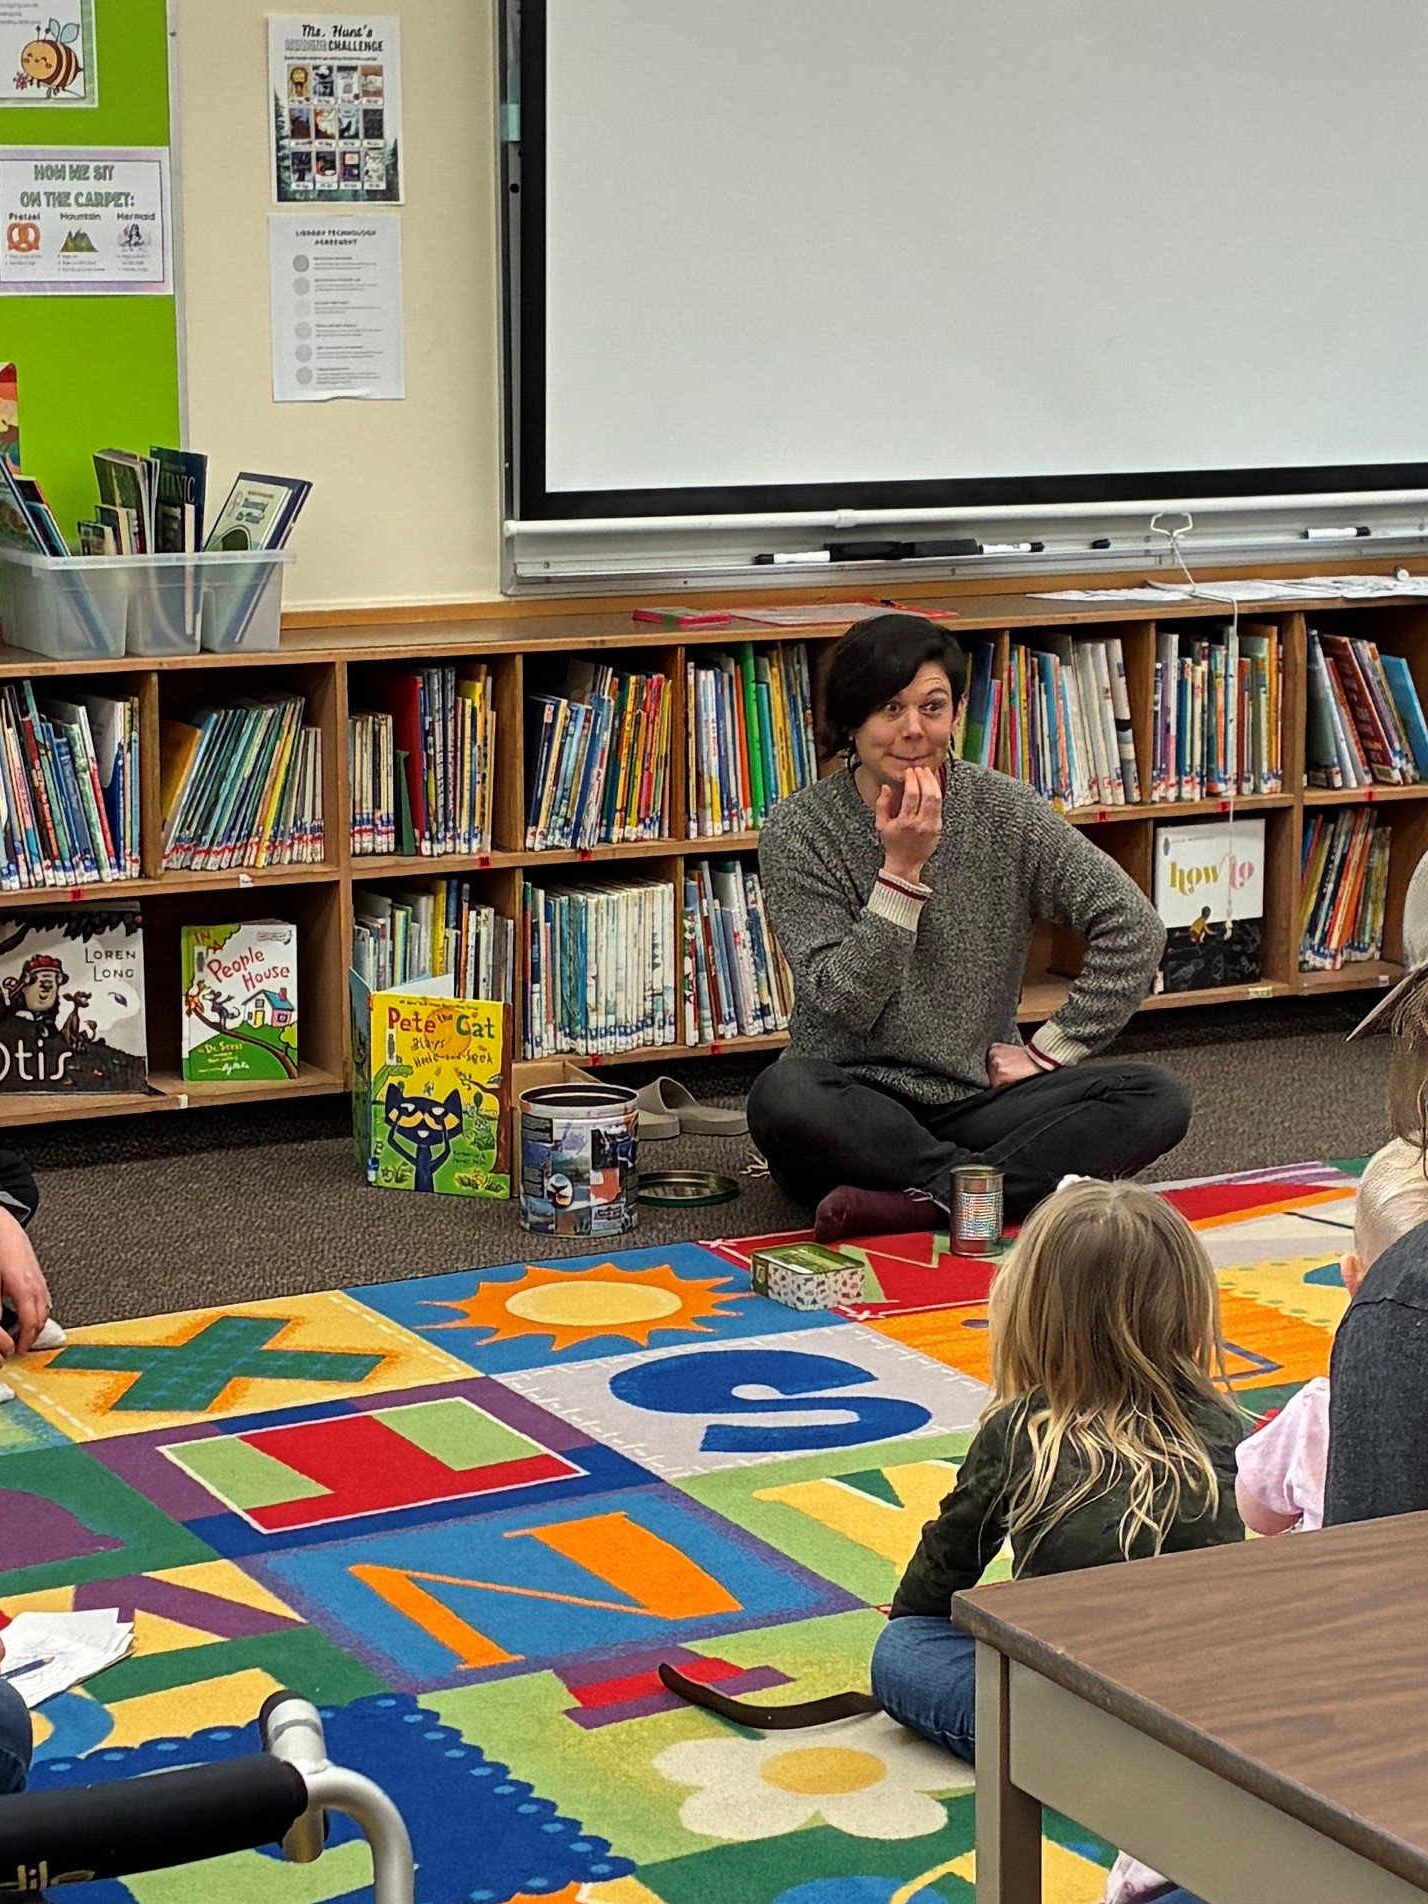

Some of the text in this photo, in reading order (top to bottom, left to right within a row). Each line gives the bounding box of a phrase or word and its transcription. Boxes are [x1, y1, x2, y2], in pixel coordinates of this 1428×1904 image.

[332, 24, 373, 37] Hunt's
[328, 40, 384, 52] CHALLENGE
[34, 164, 66, 181] HOW
[93, 164, 115, 181] SIT
[20, 191, 42, 208] ON
[44, 191, 73, 208] THE
[1168, 860, 1219, 896] how
[193, 928, 212, 944] IN
[84, 947, 137, 964] LOREN
[206, 946, 266, 984] People
[241, 965, 291, 993] House
[387, 1005, 437, 1034] Pete
[455, 1014, 496, 1039] Cat
